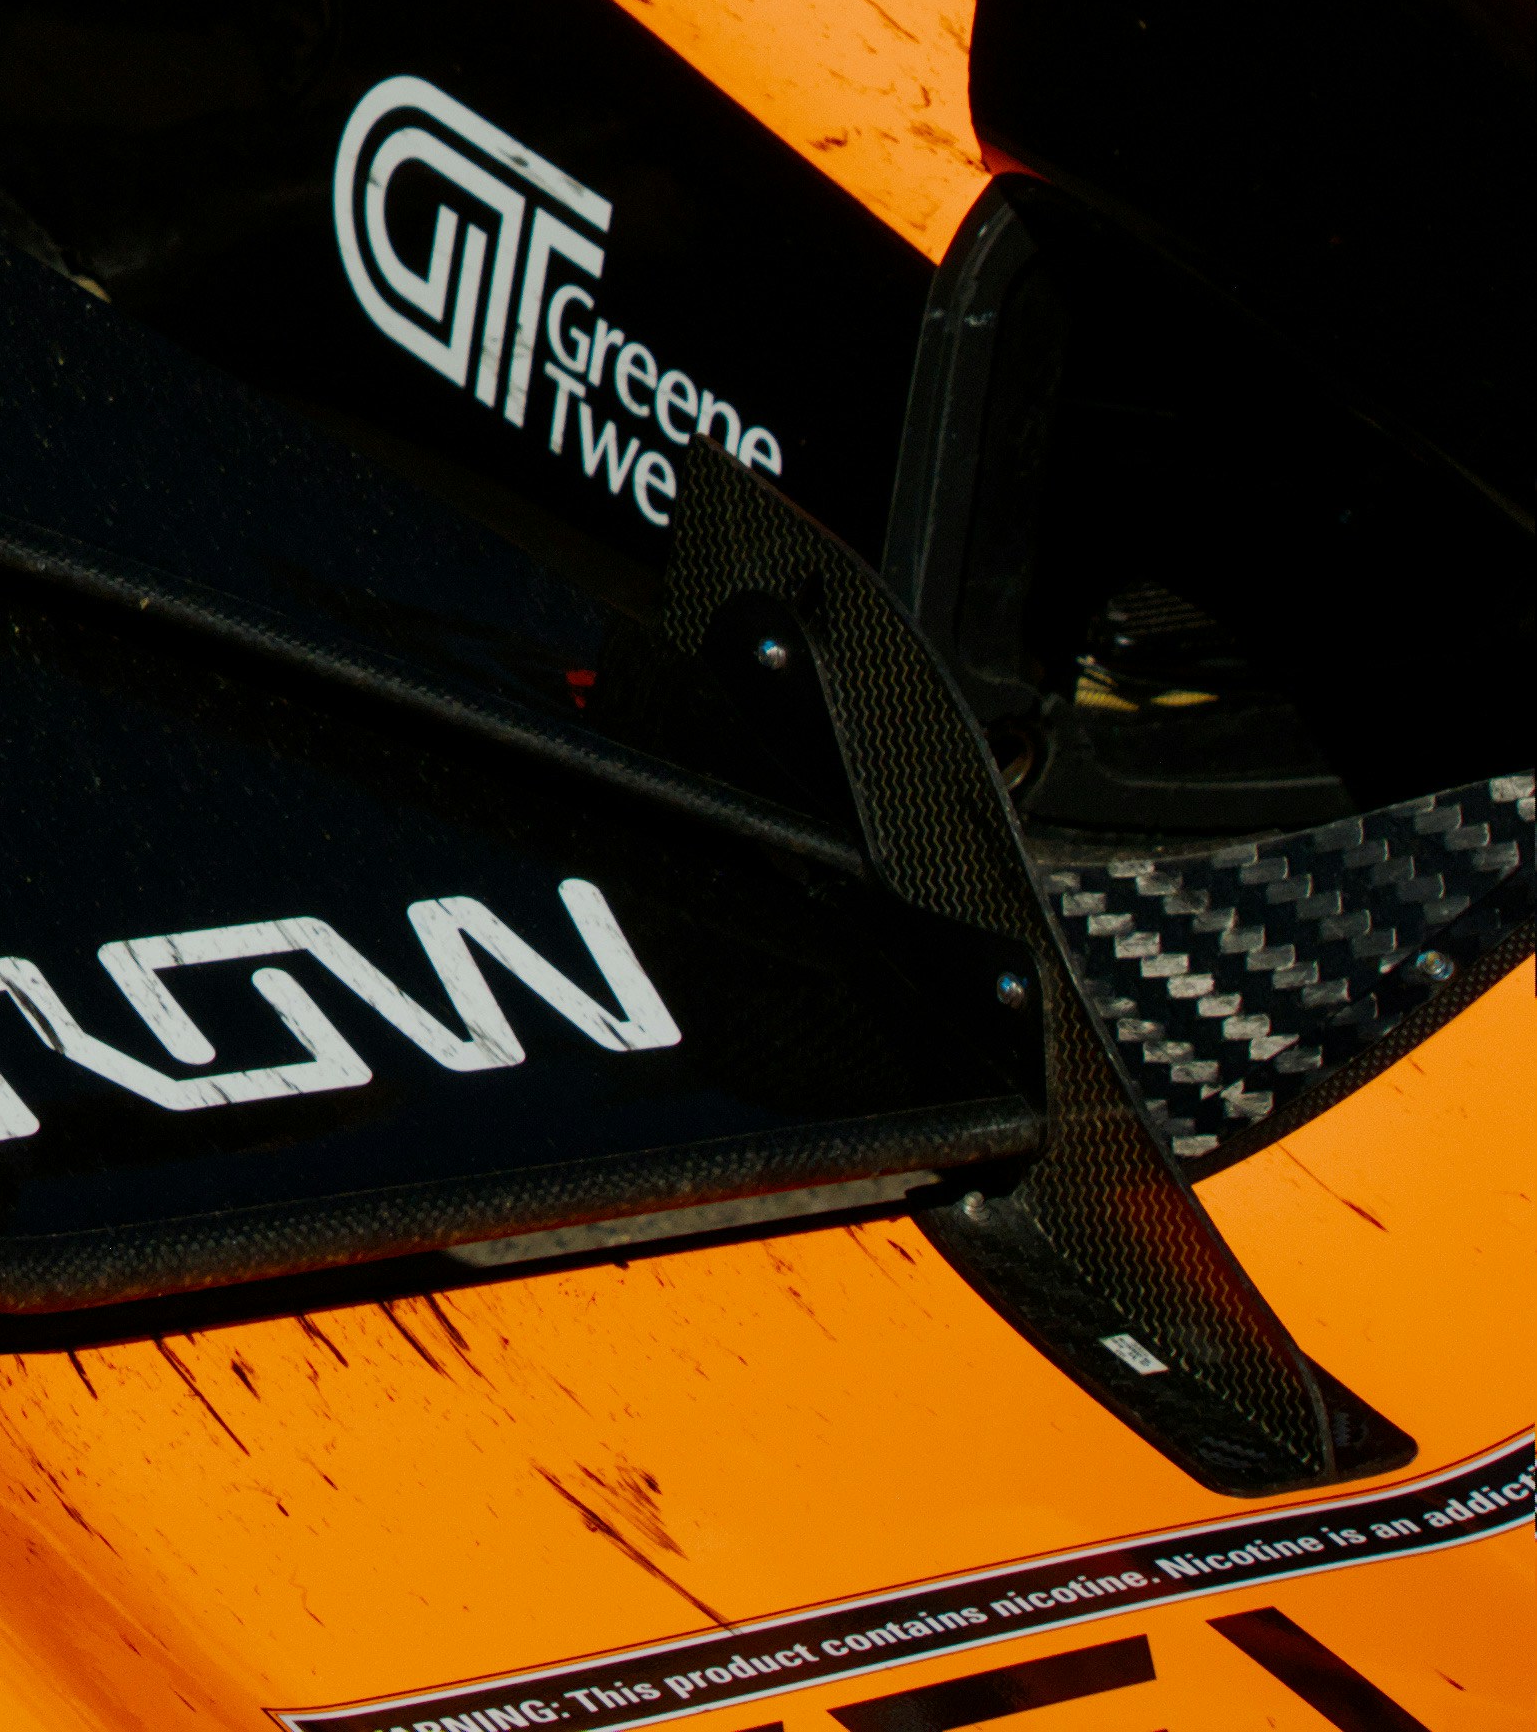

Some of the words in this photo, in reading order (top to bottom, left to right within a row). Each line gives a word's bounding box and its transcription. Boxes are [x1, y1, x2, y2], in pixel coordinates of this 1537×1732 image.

[547, 284, 782, 476] Greene
[564, 1681, 662, 1714] This
[663, 1642, 820, 1700] product
[820, 1611, 989, 1657] contains
[989, 1569, 1161, 1618] nicotine.
[1154, 1534, 1325, 1580] Nicotine
[1320, 1526, 1368, 1548] is
[1369, 1517, 1423, 1540] an
[1423, 1465, 1536, 1529] addict
